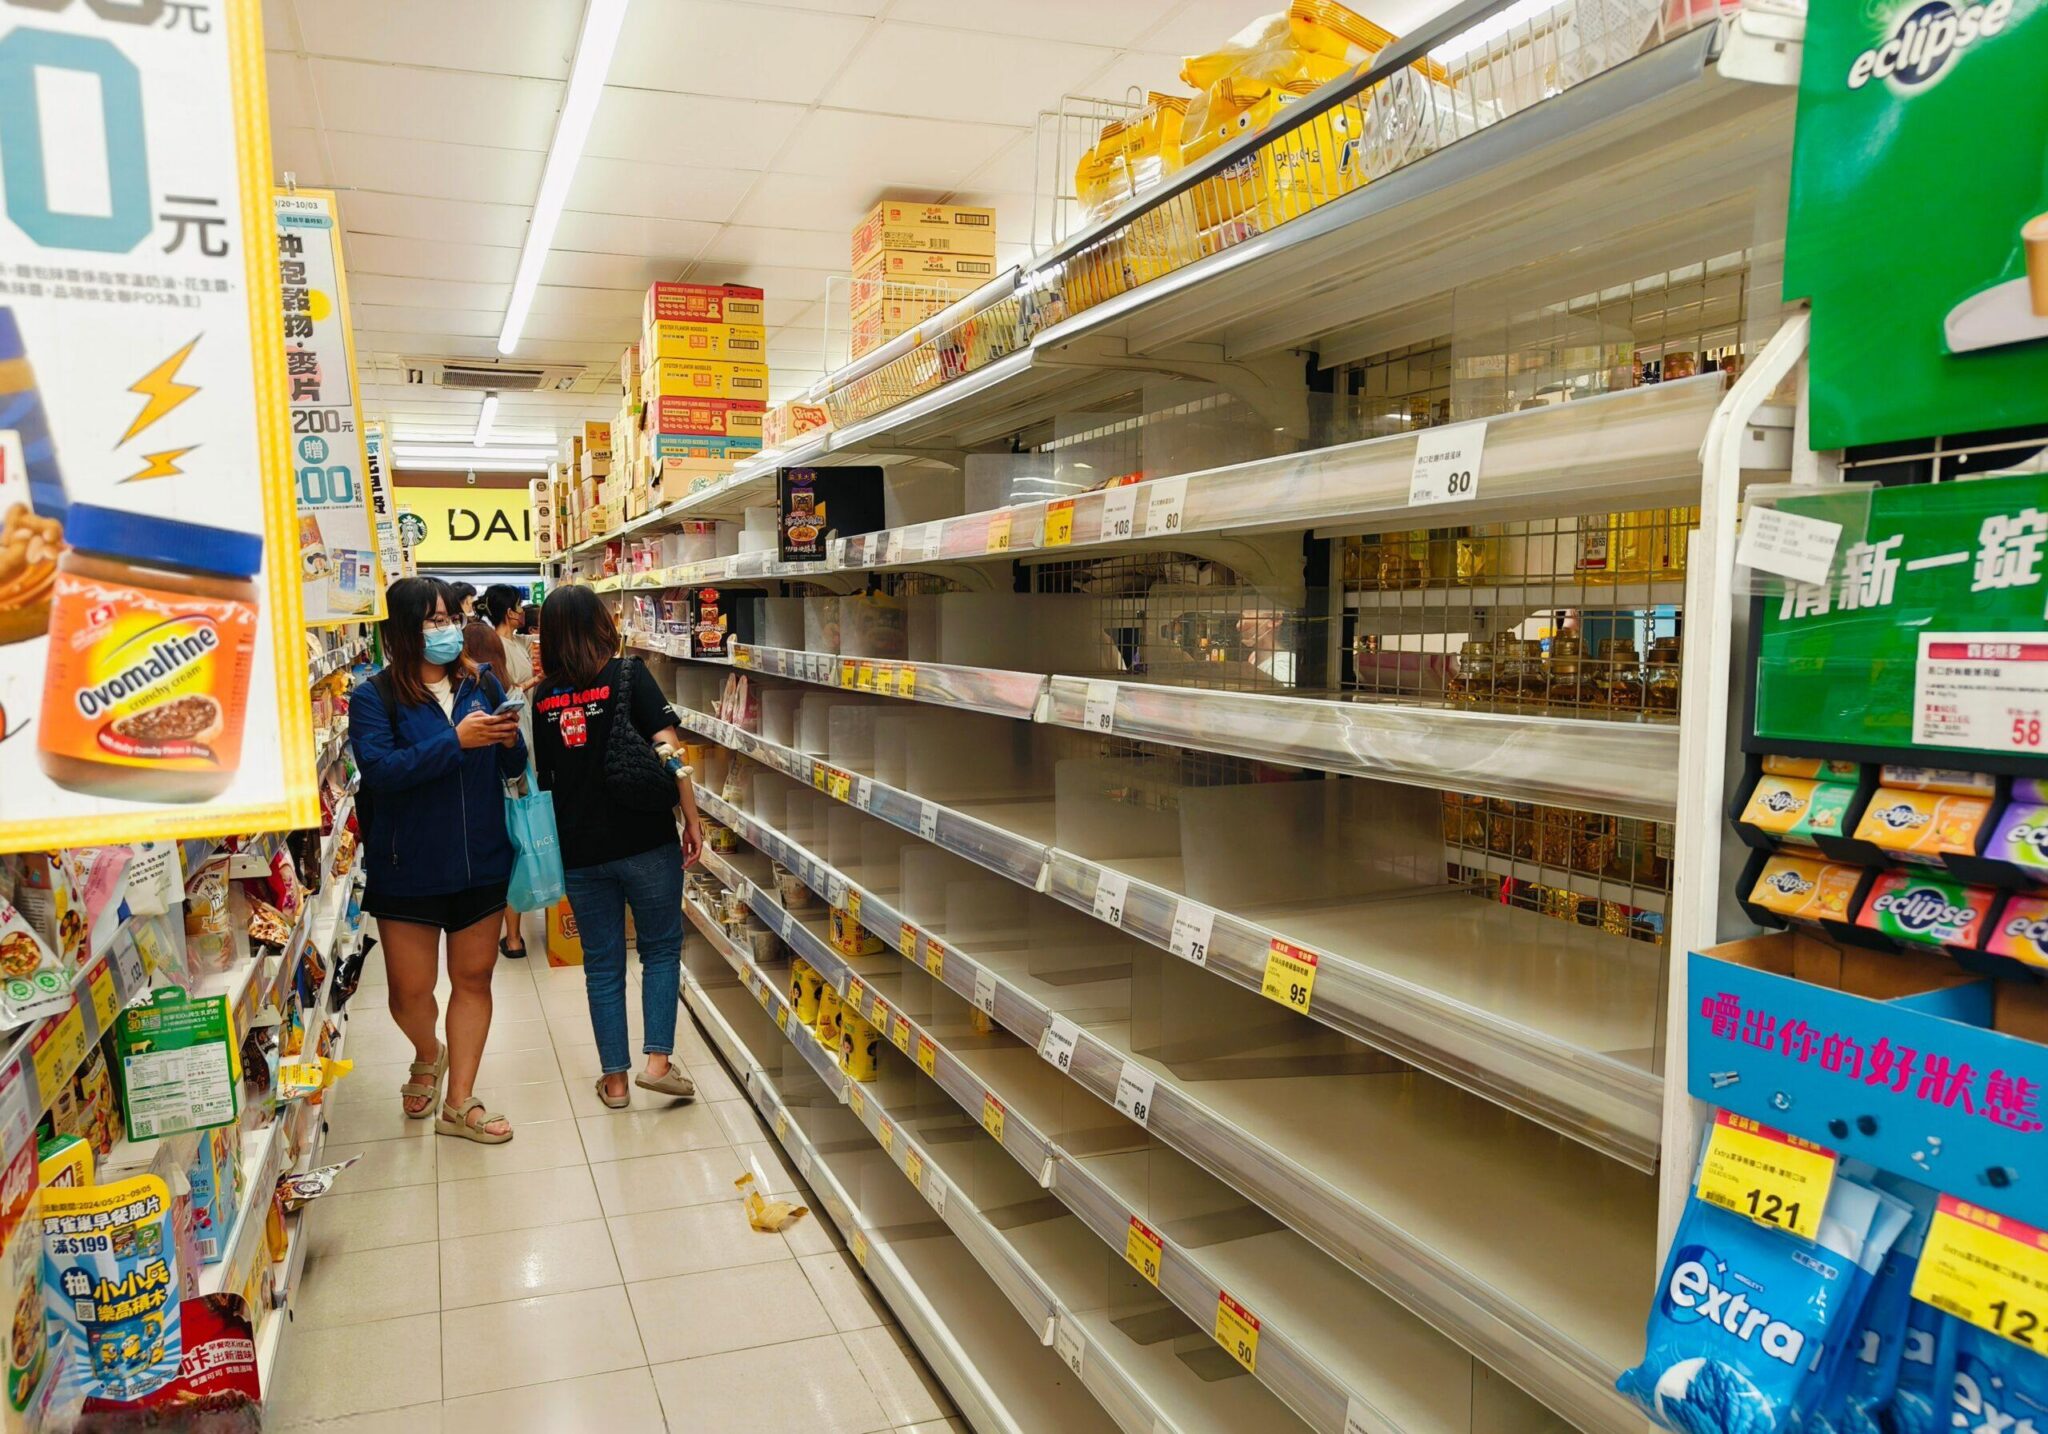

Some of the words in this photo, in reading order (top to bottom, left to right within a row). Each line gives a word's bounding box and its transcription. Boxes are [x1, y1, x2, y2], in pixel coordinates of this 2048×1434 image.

[1848, 0, 2012, 88] eclipse
[303, 440, 325, 460] 贈
[1447, 470, 1471, 494] 80
[1114, 519, 1130, 535] 108
[1166, 512, 1179, 529] 80
[1059, 525, 1069, 539] 37
[76, 625, 218, 719] Ovomaltine
[128, 680, 172, 712] crunchy
[172, 664, 203, 690] cream
[572, 685, 611, 704] KONG
[1100, 714, 1110, 729] 89
[2012, 718, 2041, 746] 58
[1757, 791, 1806, 813] eclipse
[1873, 805, 1930, 826] eclipse
[1765, 872, 1814, 893] eclipse
[1110, 906, 1120, 923] 75
[1872, 888, 1978, 927] eclipse
[1192, 941, 1205, 961] 75
[1289, 983, 1306, 1005] 95
[1058, 1050, 1069, 1068] 65
[1700, 991, 2044, 1133] 嚼出你的好狀態
[1134, 1101, 1146, 1120] 68
[43, 1194, 160, 1235] 買雀巢早餐脆片
[1746, 1188, 1800, 1229] 121
[52, 1234, 108, 1255] 滿$199
[1144, 1258, 1156, 1278] 50
[64, 1271, 92, 1298] 抽
[92, 1258, 170, 1304] 小小兵
[96, 1287, 168, 1325] 樂高積木
[1670, 1261, 1805, 1366] extra
[1989, 1301, 2048, 1343] 12
[1238, 1340, 1252, 1364] 50
